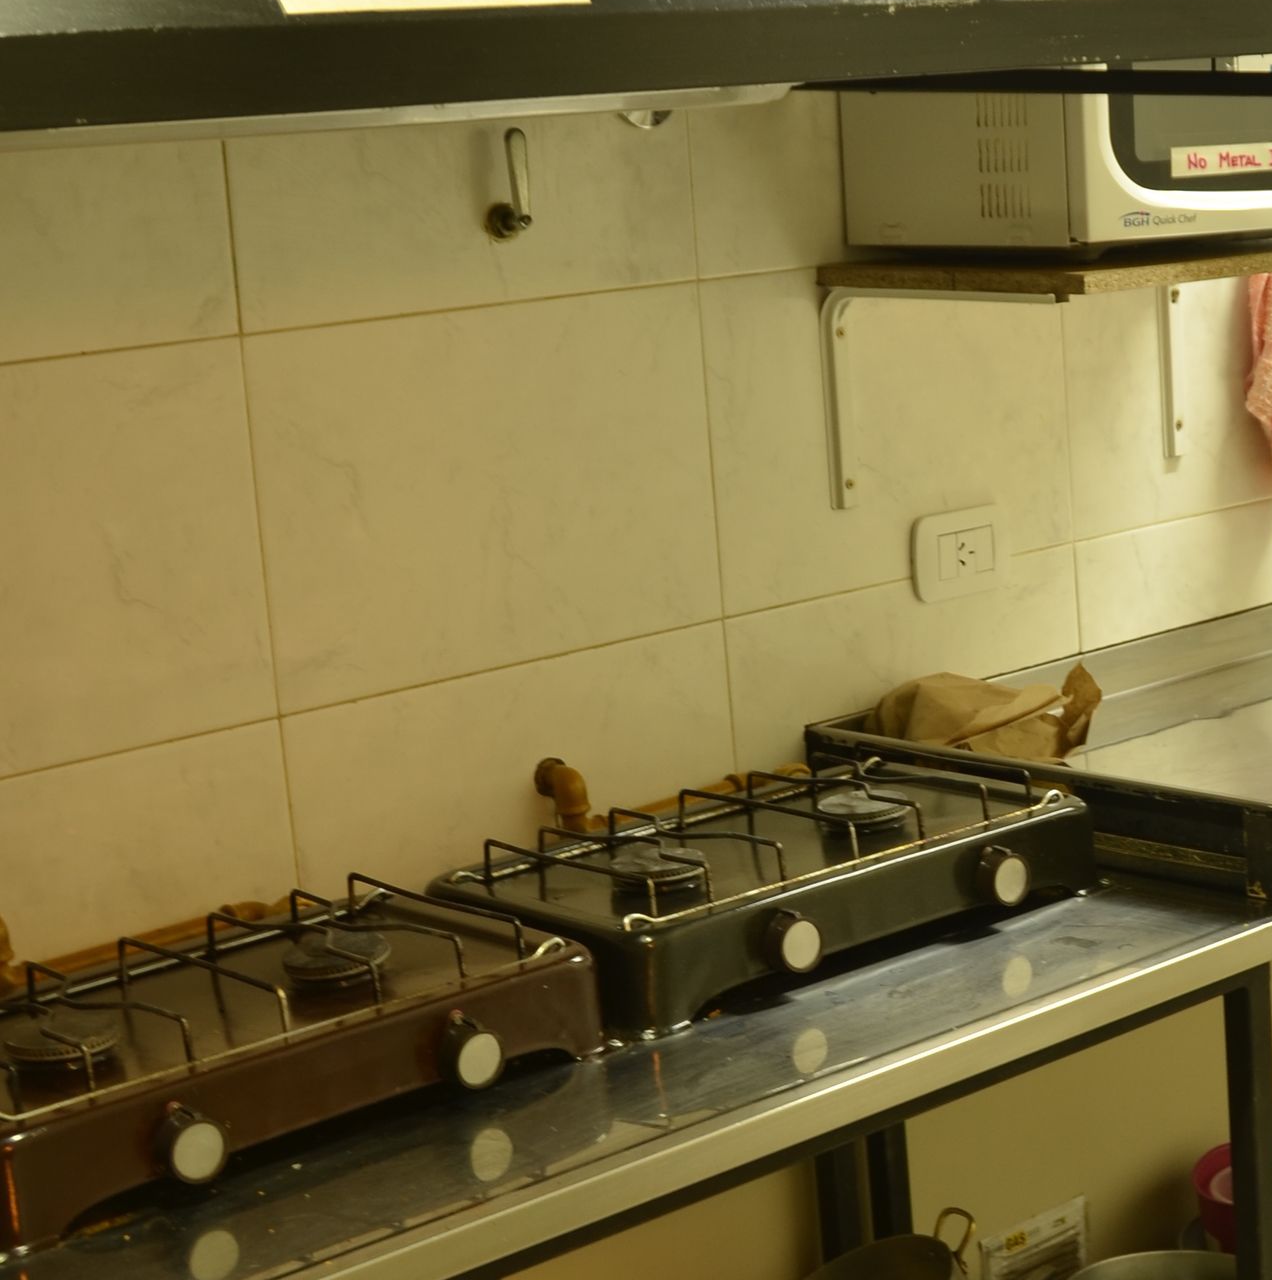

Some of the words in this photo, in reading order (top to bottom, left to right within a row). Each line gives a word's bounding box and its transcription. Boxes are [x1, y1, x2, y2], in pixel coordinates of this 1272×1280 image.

[1123, 215, 1150, 228] BGH
[1152, 214, 1177, 226] Quick
[1178, 213, 1198, 225] Chef
